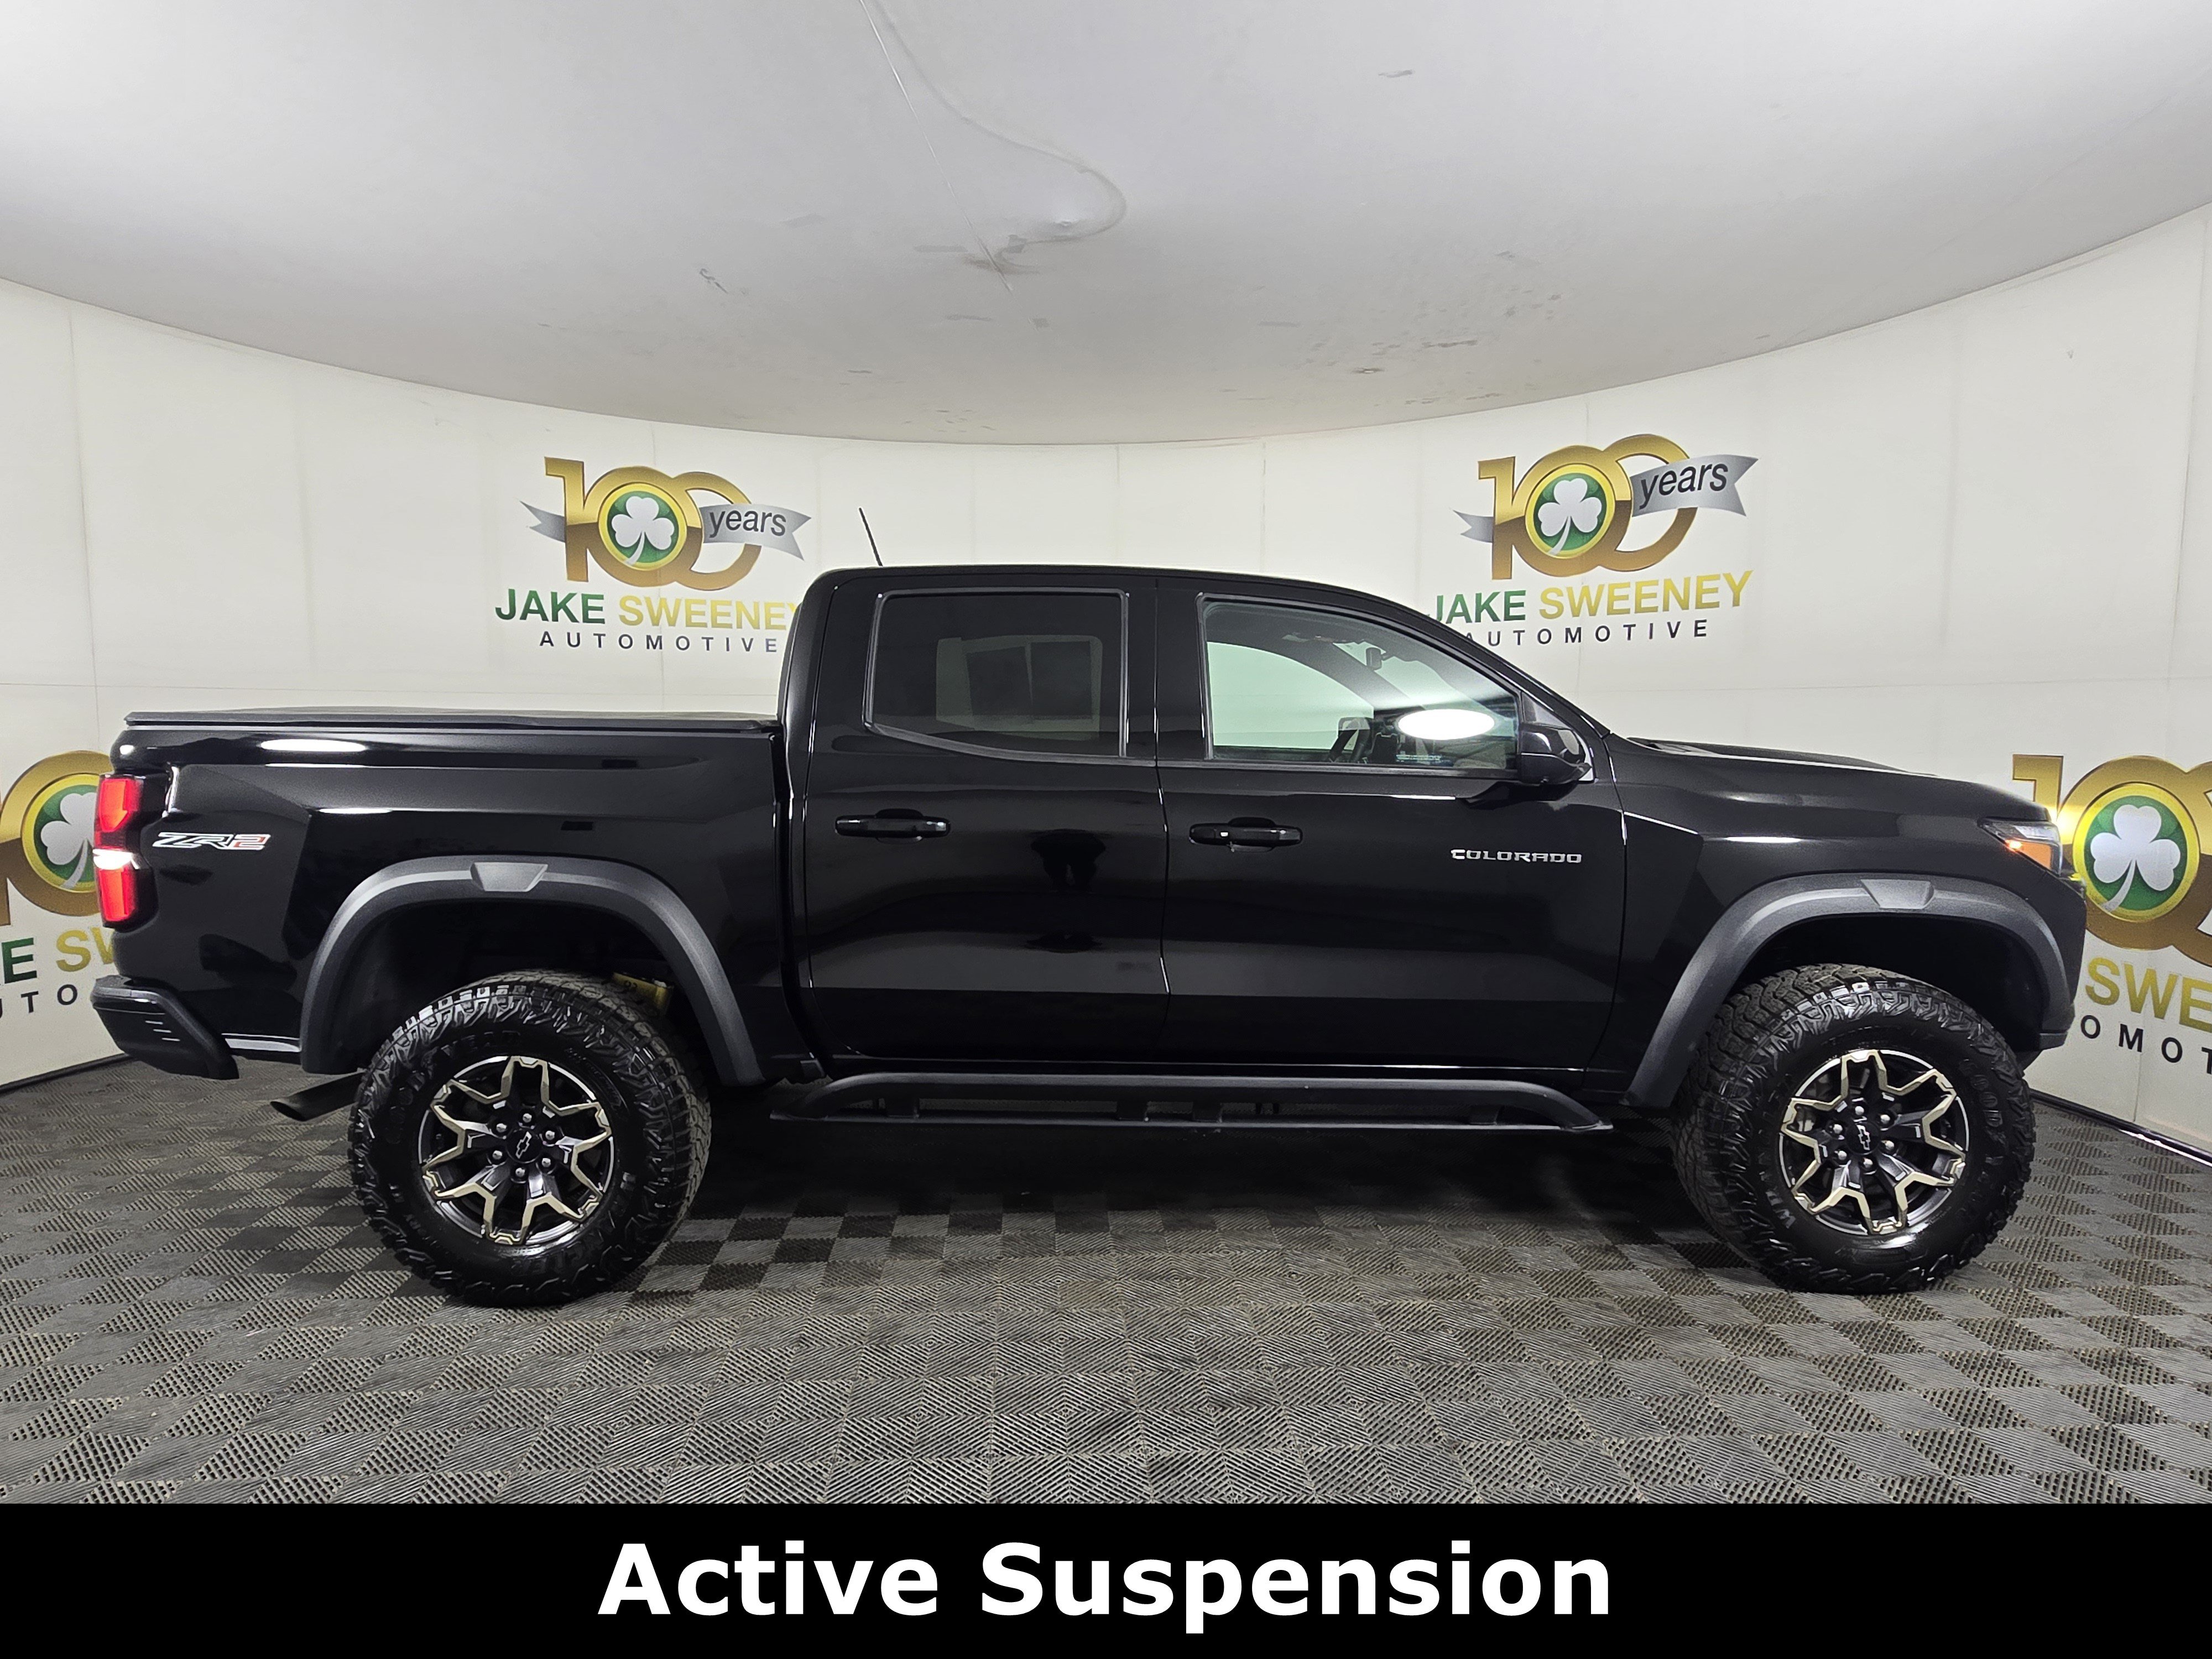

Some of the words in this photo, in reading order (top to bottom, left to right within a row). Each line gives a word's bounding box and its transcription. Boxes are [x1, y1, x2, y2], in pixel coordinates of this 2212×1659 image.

[1639, 462, 1728, 510] years
[544, 456, 762, 591] 100
[709, 510, 787, 538] years
[1478, 434, 1697, 580] 100
[495, 588, 606, 624] JAKE
[1427, 590, 1526, 624] JAKE
[1539, 570, 1754, 619] SWEENEY
[540, 631, 777, 653] AUTOMOTIVE
[152, 832, 271, 850] ZR2
[1451, 849, 1582, 863] COLORADO
